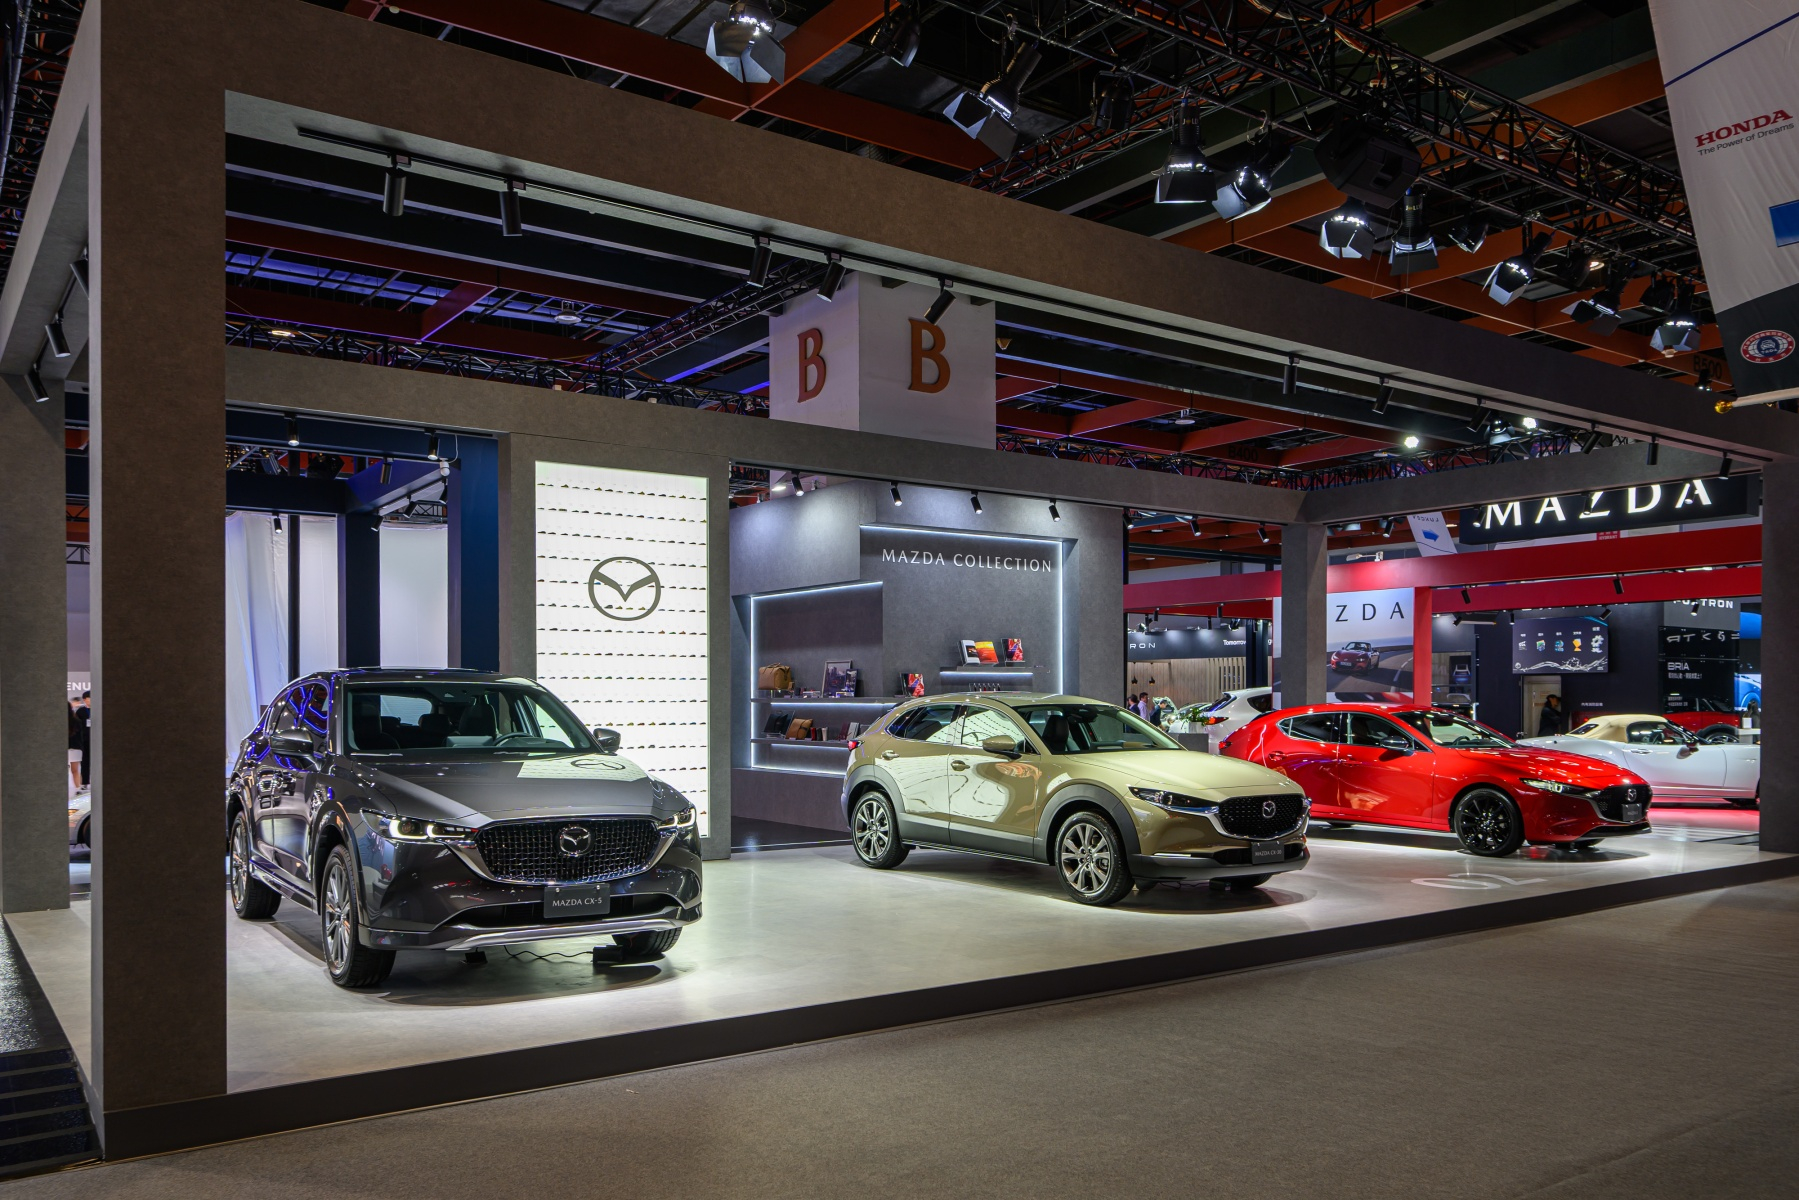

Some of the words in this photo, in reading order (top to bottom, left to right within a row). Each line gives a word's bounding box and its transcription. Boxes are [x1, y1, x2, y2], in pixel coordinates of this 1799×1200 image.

[1695, 109, 1793, 147] HONDA
[1697, 146, 1716, 156] The
[1716, 137, 1744, 151] Power
[1745, 133, 1755, 142] of
[1757, 122, 1795, 139] Dreams
[797, 328, 827, 403] B
[908, 318, 951, 394] B
[1693, 353, 1723, 379] B500
[1228, 445, 1259, 461] B400
[1485, 479, 1712, 529] MAZDA
[881, 548, 946, 566] MAZDA
[953, 553, 1051, 573] COLLECTION
[1335, 602, 1404, 622] ZDA
[1667, 662, 1690, 671] BRIA
[552, 899, 582, 907] MAZDA
[584, 897, 602, 905] CX-5
